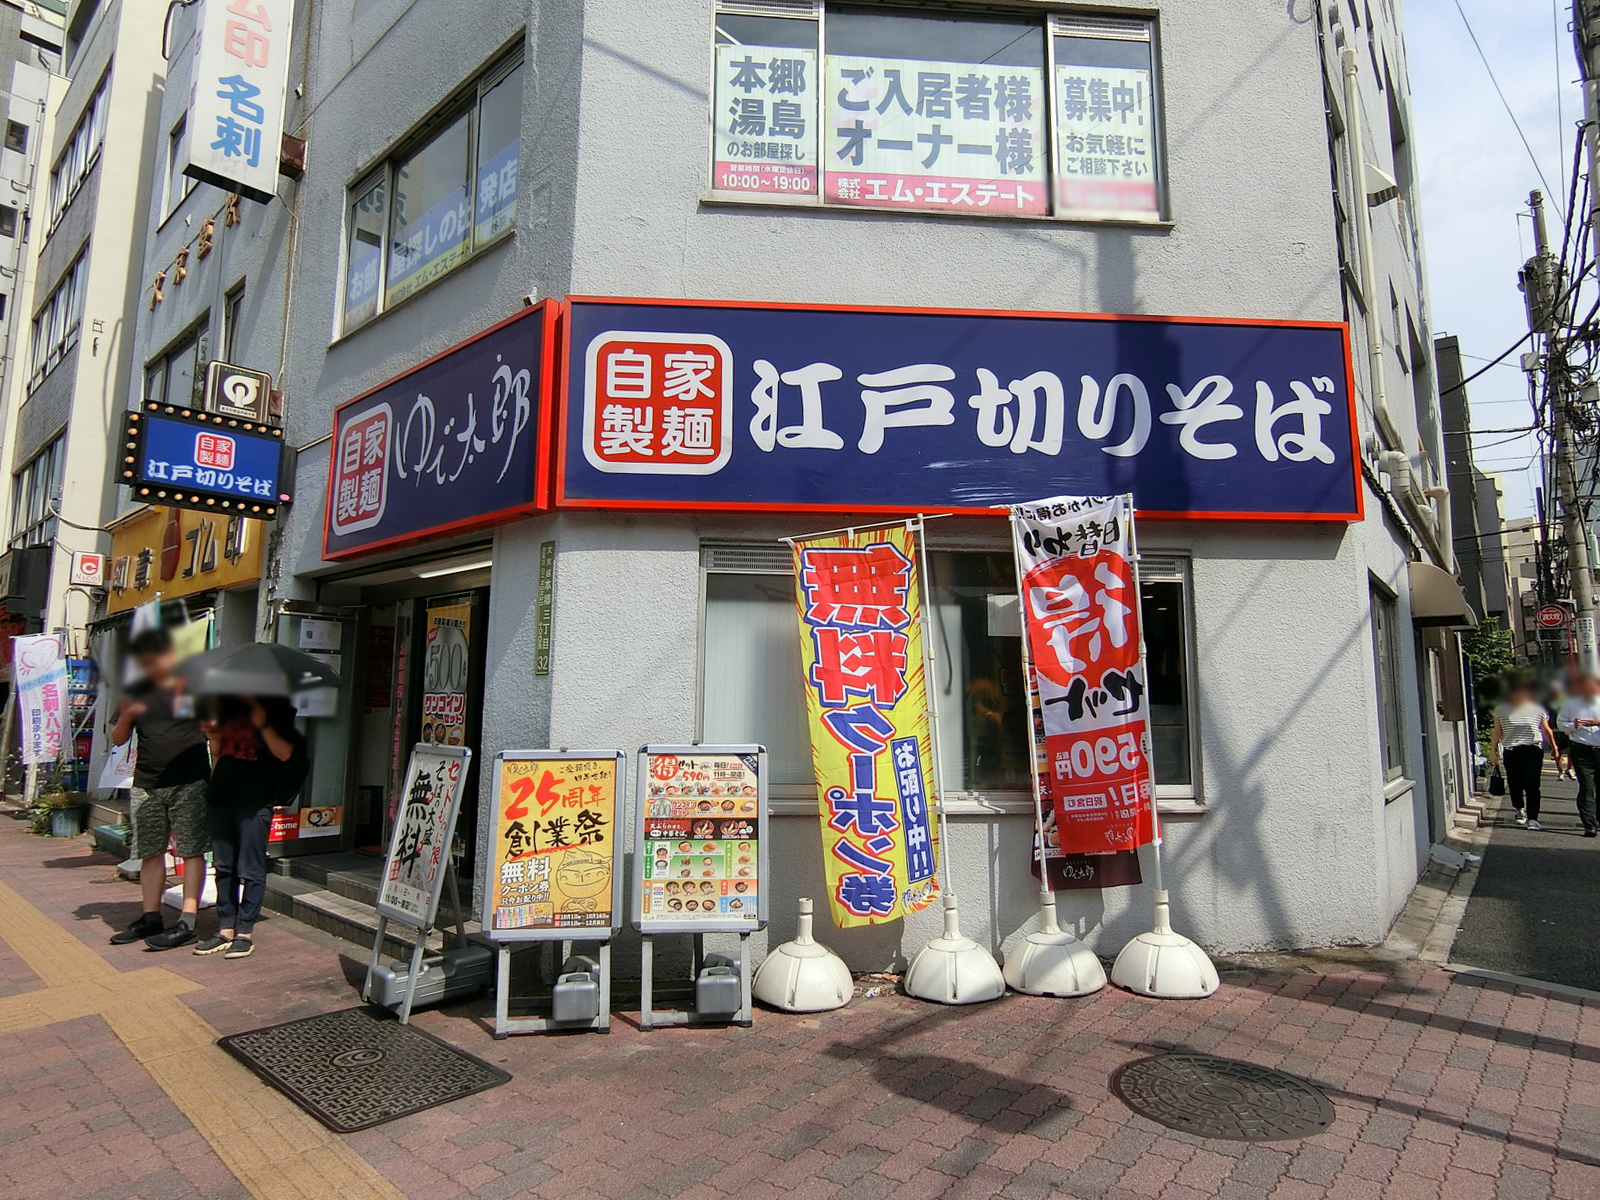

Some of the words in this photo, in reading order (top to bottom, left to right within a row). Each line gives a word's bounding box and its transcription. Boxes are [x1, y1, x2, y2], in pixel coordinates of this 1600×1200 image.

[729, 56, 806, 97] 本郷
[838, 66, 1033, 125] ご入居者様
[210, 74, 265, 168] 名刺
[728, 97, 806, 140] 湯島
[1063, 76, 1144, 126] 募集中!
[727, 141, 806, 161] のお部屋探し
[836, 119, 1034, 175] オーナー様
[1065, 132, 1146, 155] お気軽に
[1066, 156, 1148, 177] ご相談下さい
[865, 180, 1034, 207] エム・エステート
[605, 348, 715, 402] 自家
[600, 404, 715, 460] 製麺
[749, 357, 1337, 465] 江戸切りそば
[199, 450, 231, 467] 製麺
[200, 436, 233, 453] 自家
[343, 420, 386, 475] 自家
[148, 459, 272, 497] 江戸切りそば
[338, 467, 382, 522] 製麺
[182, 514, 246, 580] ゴム印
[428, 642, 463, 691] 500
[537, 655, 548, 670] 32
[424, 695, 464, 716] ワンコイン
[443, 713, 463, 725] セット
[656, 757, 676, 777] 得
[504, 769, 606, 820] 25周年
[395, 769, 434, 879] 無料
[427, 759, 460, 884] セットものに限り
[504, 808, 611, 859] 創業祭
[501, 856, 551, 884] 無料
[501, 881, 550, 896] クーポン券
